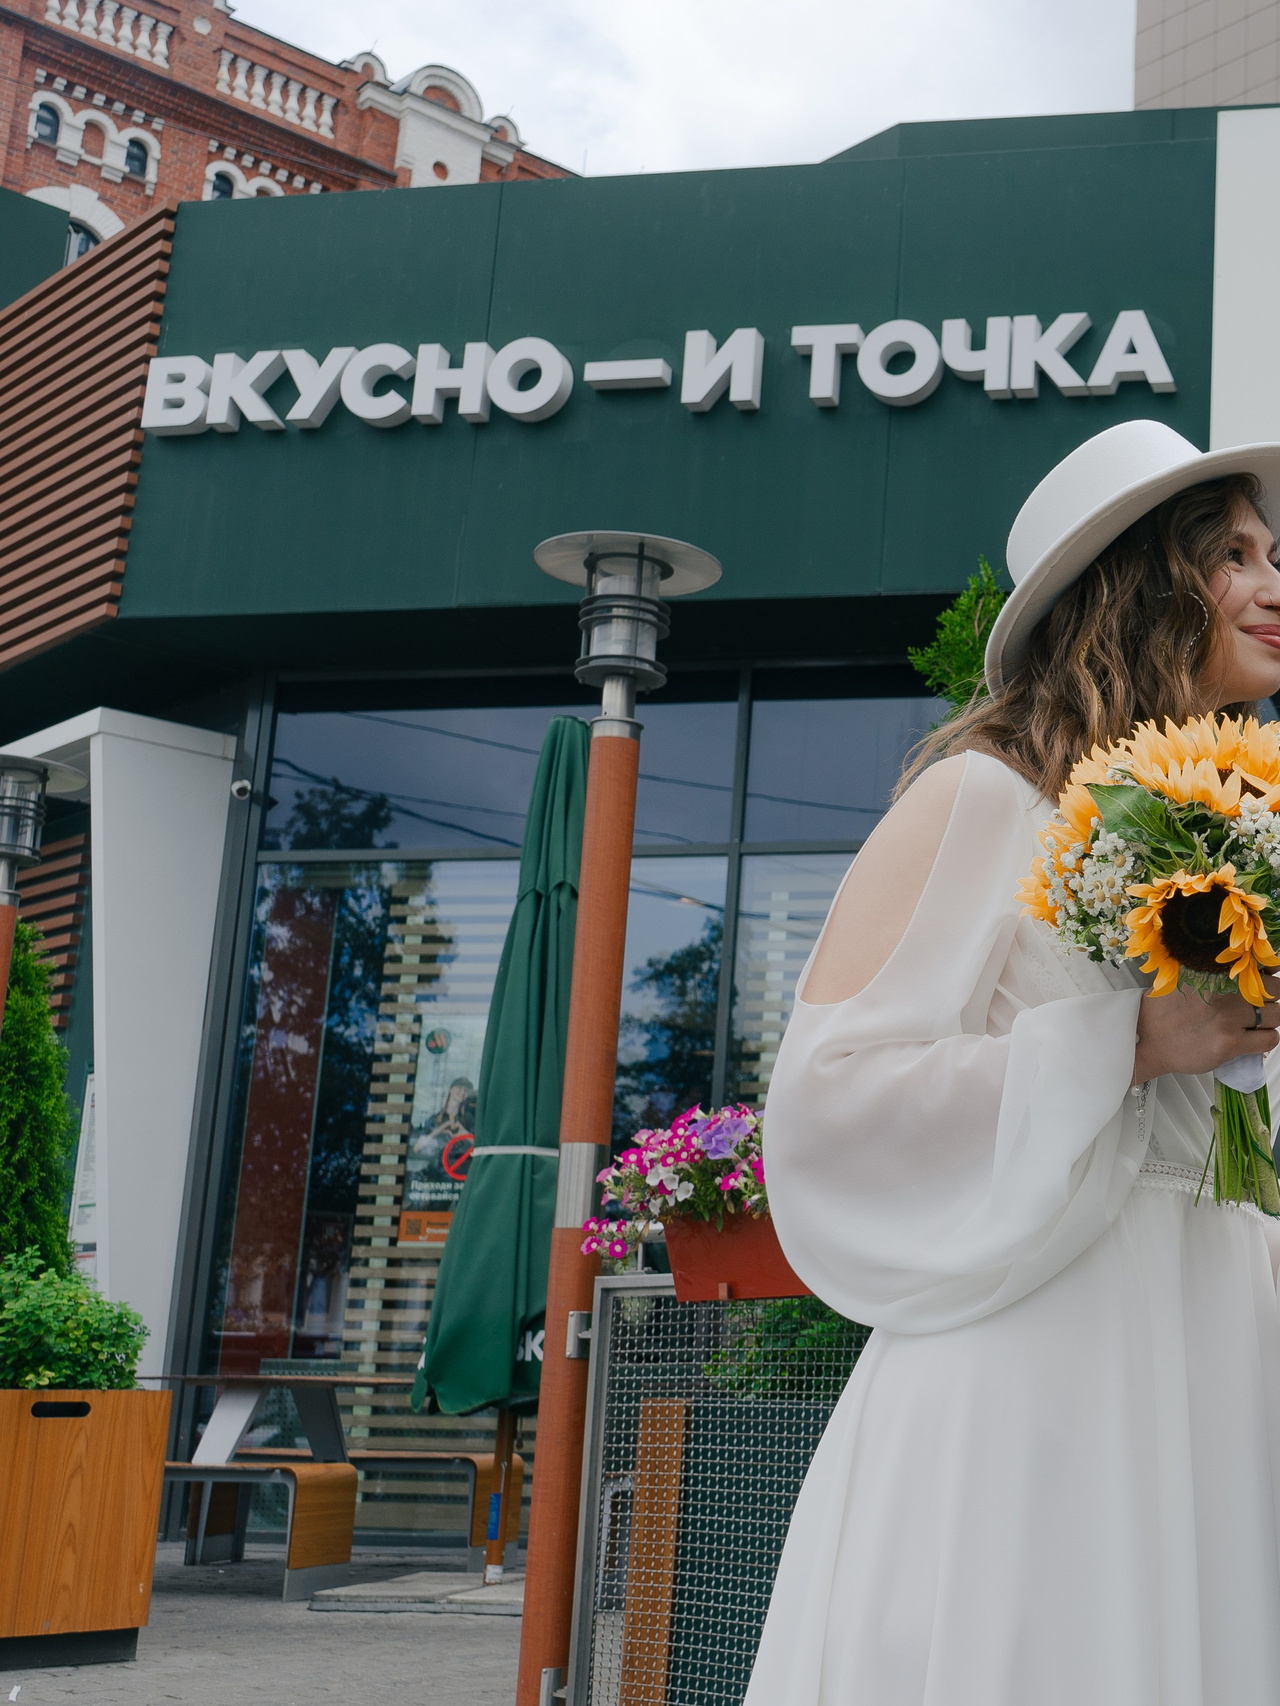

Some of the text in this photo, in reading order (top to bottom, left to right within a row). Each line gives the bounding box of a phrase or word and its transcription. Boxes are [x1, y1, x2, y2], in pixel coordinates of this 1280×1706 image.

[141, 337, 574, 437] ВКУСНО
[681, 327, 765, 413] И
[791, 310, 1177, 407] ТОЧКА
[411, 1180, 452, 1191] Приходи
